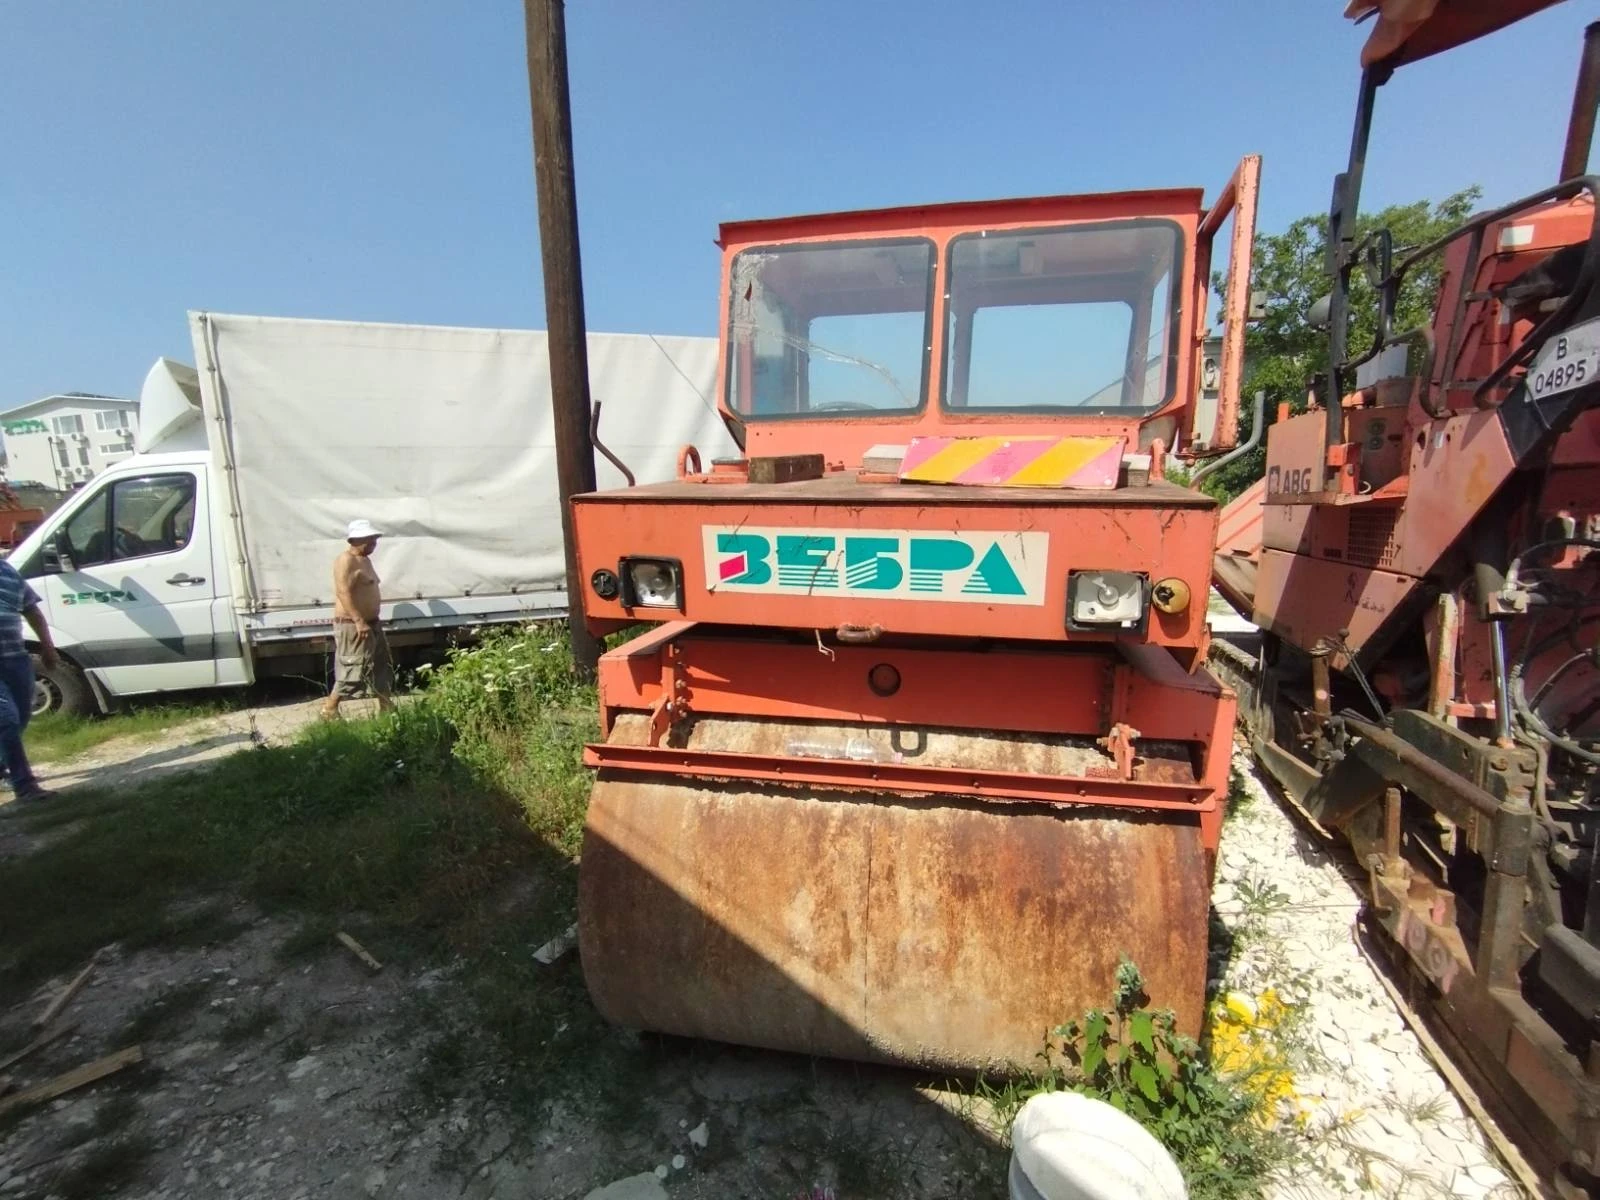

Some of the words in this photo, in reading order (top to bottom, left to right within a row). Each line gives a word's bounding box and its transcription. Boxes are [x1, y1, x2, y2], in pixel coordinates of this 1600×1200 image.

[1535, 359, 1587, 393] 04895
[1282, 467, 1312, 496] ABG
[716, 534, 1027, 596] ЗЕБРА
